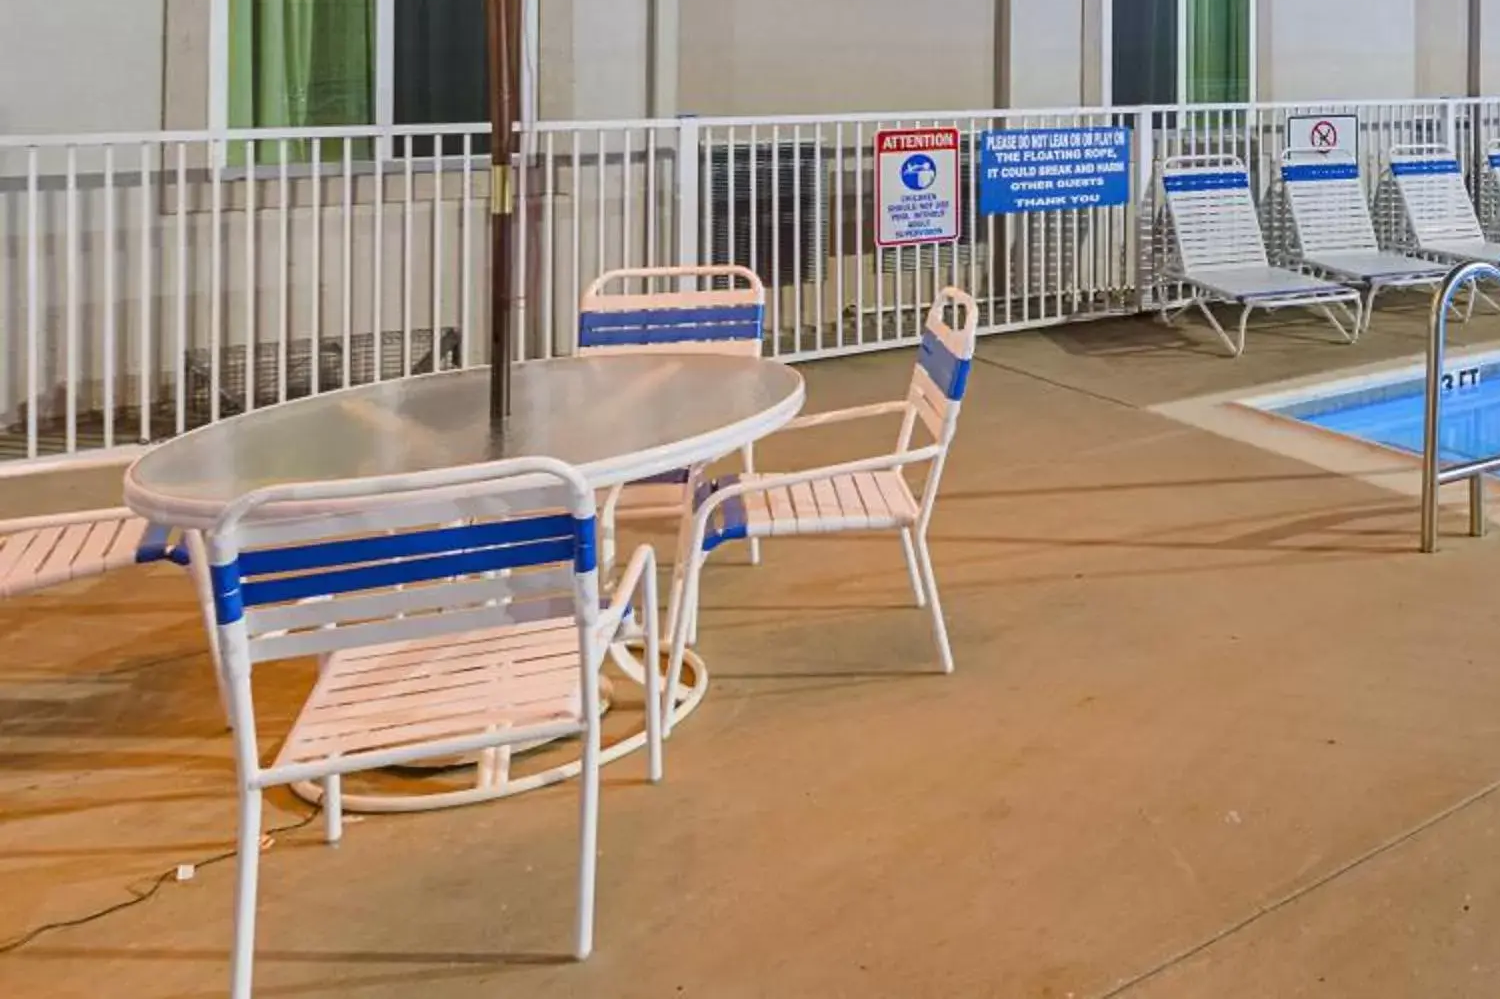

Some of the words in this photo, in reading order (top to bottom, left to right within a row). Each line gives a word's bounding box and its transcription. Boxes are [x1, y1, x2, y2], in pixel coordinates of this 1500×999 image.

[883, 133, 954, 150] ATTENTION
[987, 135, 1016, 151] PLEASE
[1019, 135, 1030, 149] DO
[1032, 134, 1047, 148] NOT
[1051, 134, 1068, 148] LEAN
[996, 152, 1021, 163] THE
[1024, 149, 1081, 161] FLOATING
[987, 168, 998, 179] IT
[1001, 166, 1036, 178] COULD
[1039, 164, 1073, 176] BREAK
[1075, 163, 1094, 174] AND
[1097, 161, 1125, 172] HARM
[1010, 179, 1053, 191] OTHER
[1057, 177, 1104, 188] GUESTS
[1015, 196, 1066, 208] THANK
[1071, 194, 1100, 205] YOU
[1441, 373, 1454, 390] 3
[1459, 367, 1479, 388] FT
